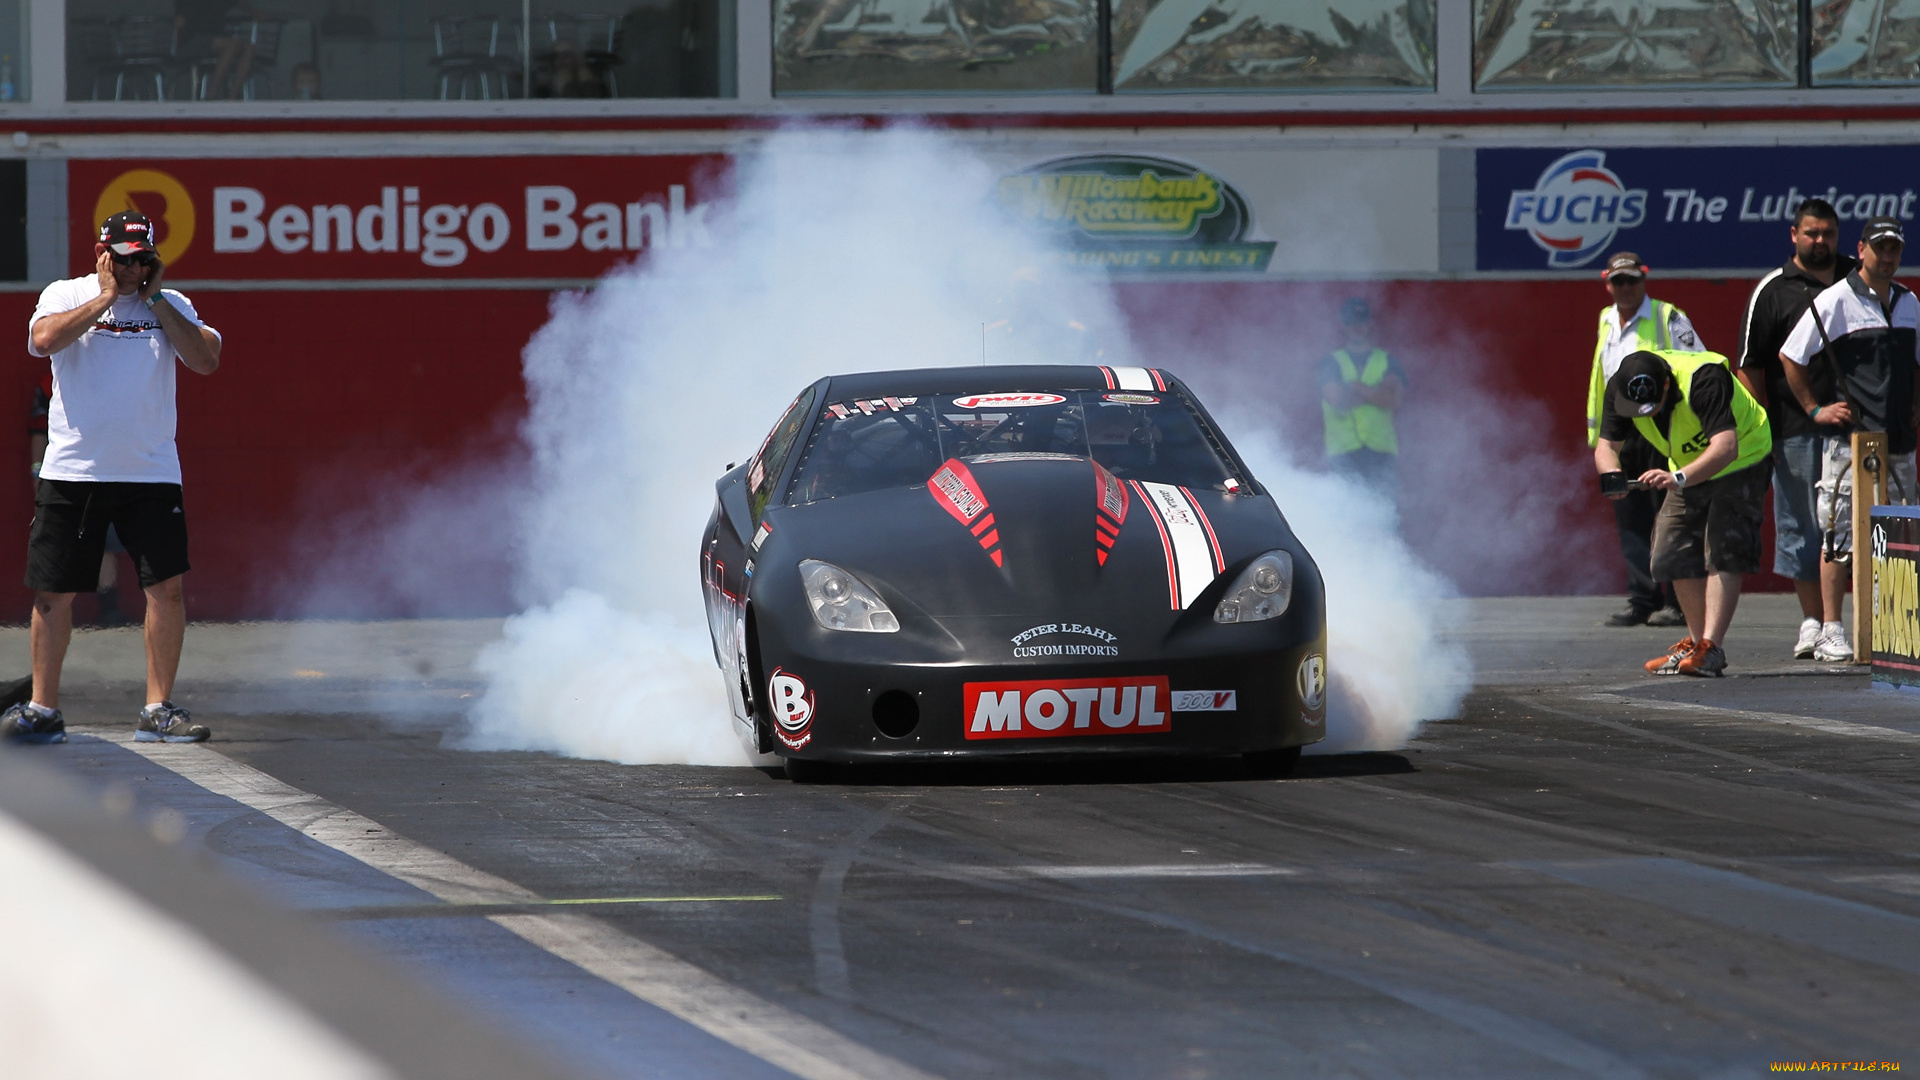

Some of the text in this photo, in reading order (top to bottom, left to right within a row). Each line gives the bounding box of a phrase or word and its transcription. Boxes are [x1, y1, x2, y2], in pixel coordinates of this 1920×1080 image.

[1001, 172, 1216, 220] Willowbank
[1511, 194, 1643, 224] FUCHS
[1664, 186, 1917, 222] The Lubicant
[213, 185, 712, 267] Bendigo Bank
[1064, 200, 1196, 230] Raceway
[1011, 623, 1118, 646] PETER LEAHY
[1013, 645, 1119, 658] CUSTOM IMPORTS
[970, 686, 1165, 733] MOTUL
[1177, 692, 1231, 711] 300V
